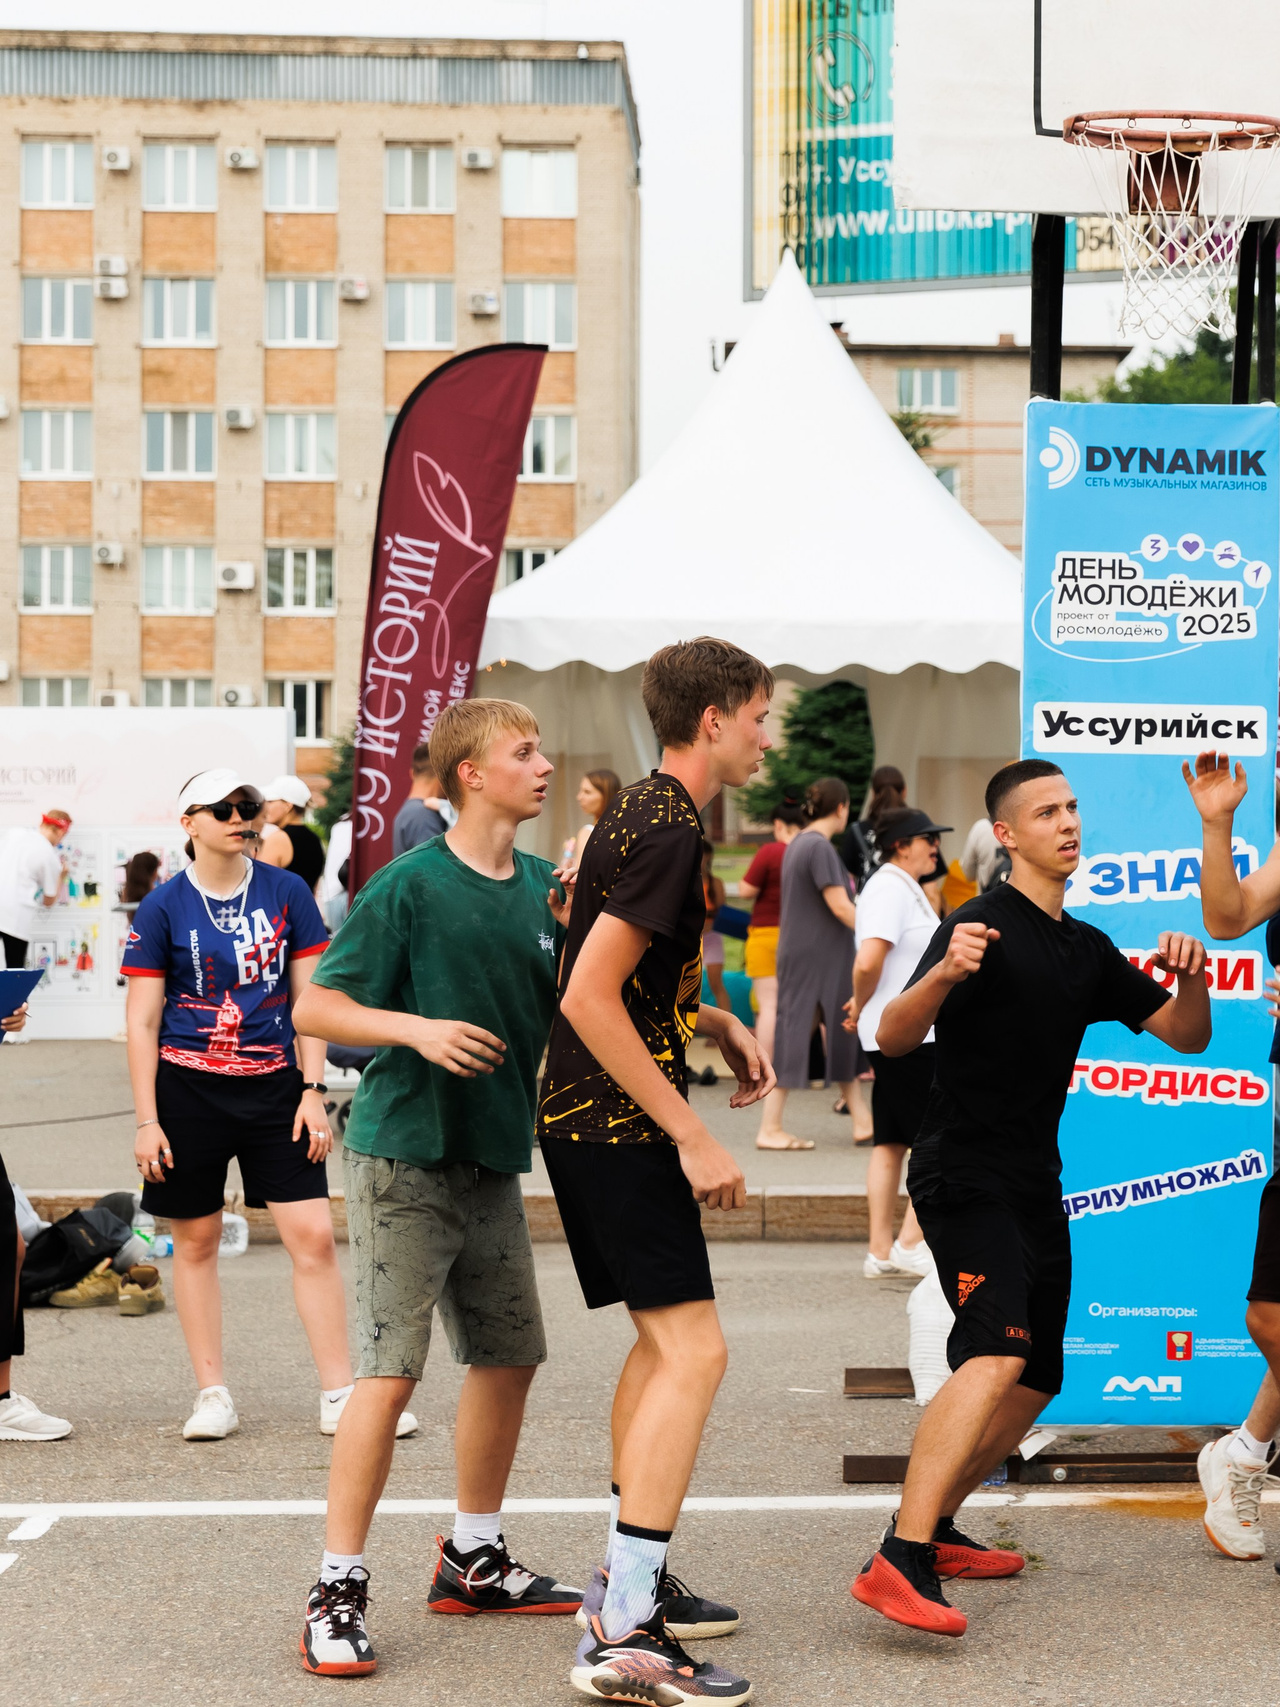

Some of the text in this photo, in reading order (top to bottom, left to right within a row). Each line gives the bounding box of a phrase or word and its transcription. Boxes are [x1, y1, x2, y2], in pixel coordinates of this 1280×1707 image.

[1085, 446, 1267, 477] DYNAMIK
[1084, 476, 1268, 492] СЕТЬ МУЗЫКАЛЬНЫХ МАГАЗИНОВ
[1058, 557, 1138, 583] ДЕНЬ
[1058, 580, 1238, 611] МОЛОДЁЖИ
[1057, 611, 1110, 622] проект от
[1057, 624, 1163, 638] росмолодёжь
[1182, 612, 1251, 637] 2025
[362, 531, 441, 759] ИСТОРИЙ
[416, 689, 443, 746] ИЛОЙ
[1042, 710, 1259, 745] Уссурийск
[1068, 1063, 1265, 1101] ГОРДИСЬ
[1062, 1153, 1263, 1217] ПРИУМНОЖАЙ
[958, 1274, 986, 1307] adidas
[1088, 1302, 1198, 1318] Организаторы:
